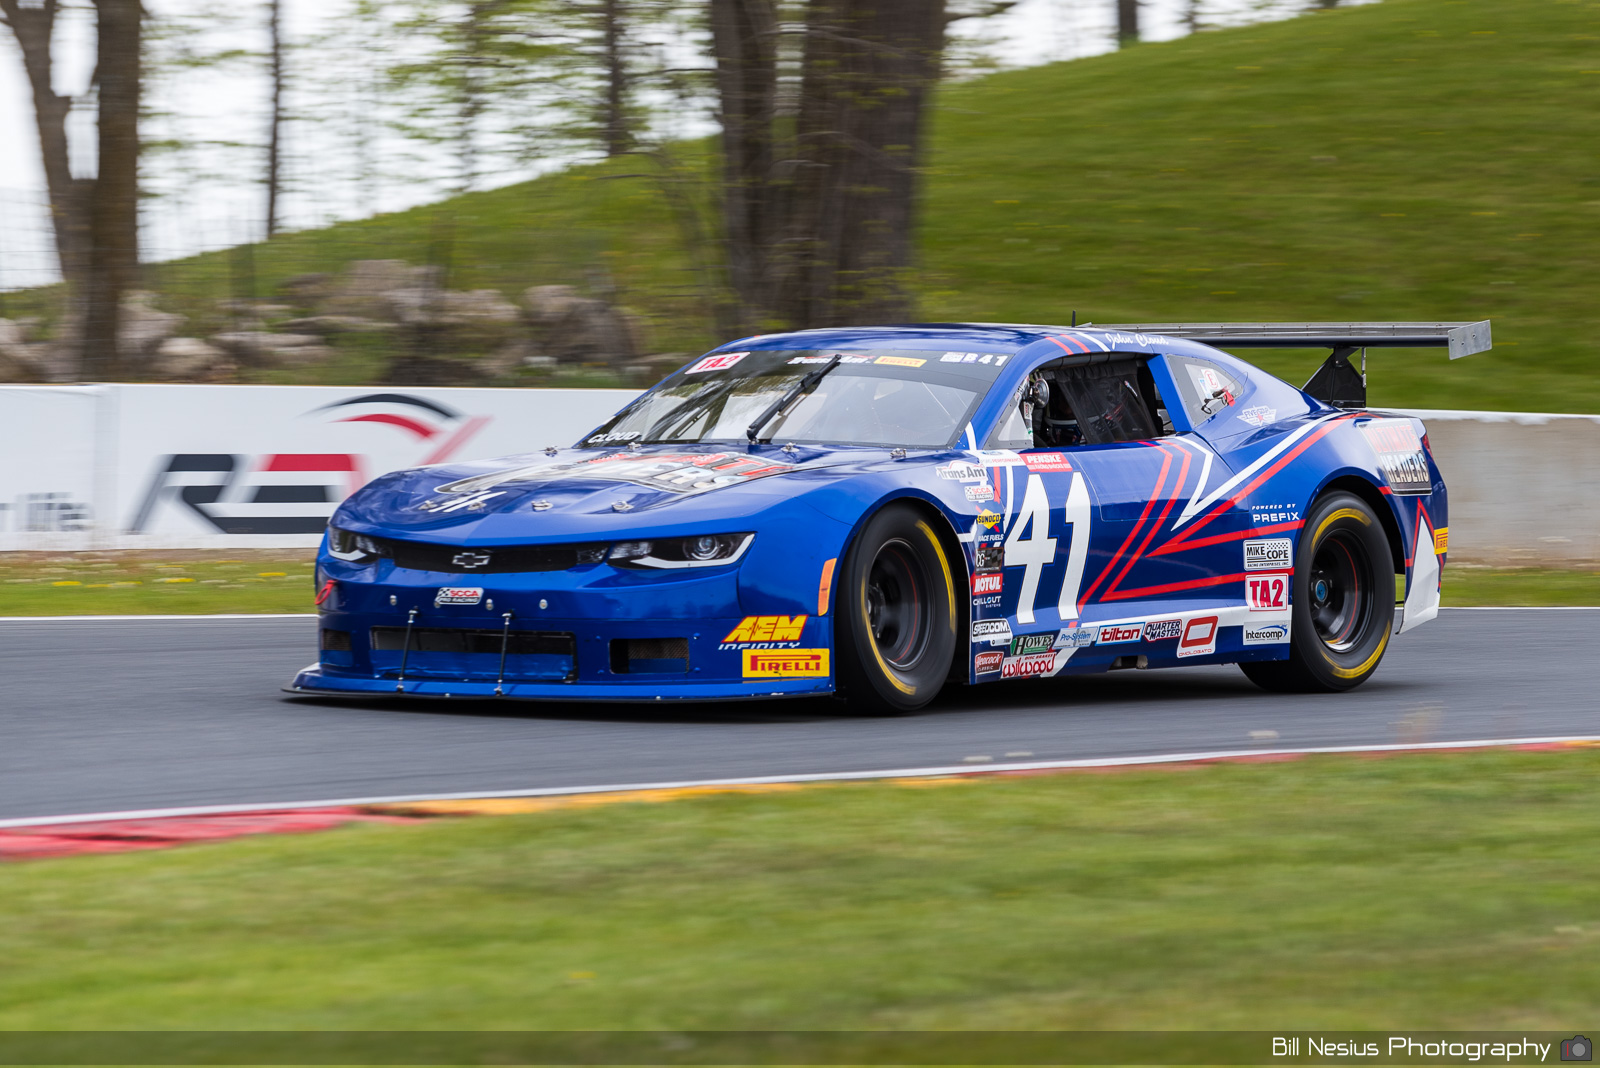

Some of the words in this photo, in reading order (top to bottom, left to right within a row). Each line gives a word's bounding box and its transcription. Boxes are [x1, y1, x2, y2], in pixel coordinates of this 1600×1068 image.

[696, 355, 740, 371] TA2
[978, 354, 1008, 367] 41
[587, 431, 640, 444] CLOUD
[1364, 425, 1422, 453] ULTIMATE
[1026, 454, 1061, 464] PENSKE
[939, 468, 965, 480] Trans
[1380, 452, 1429, 483] HEADERS
[971, 487, 992, 495] SCCA
[978, 514, 1000, 523] SUNOCO
[1252, 511, 1300, 523] PREFIX
[977, 534, 990, 542] RACE
[989, 533, 1004, 541] FUELS
[1004, 471, 1091, 624] 41
[1246, 546, 1265, 556] MIKE
[1266, 549, 1289, 560] COPE
[974, 576, 1001, 593] MOTUL
[450, 590, 479, 598] SCCA
[1249, 579, 1284, 608] TA2
[721, 614, 809, 643] AEM
[1101, 627, 1142, 642] tilton
[1145, 621, 1180, 635] QUARTER
[1149, 628, 1180, 641] MASTER
[1245, 630, 1283, 641] Intercomp
[718, 642, 801, 650] INFINITY
[1178, 648, 1213, 657] OMOLOGATO
[750, 654, 822, 671] PIRELLI
[1002, 652, 1057, 677] wilwood
